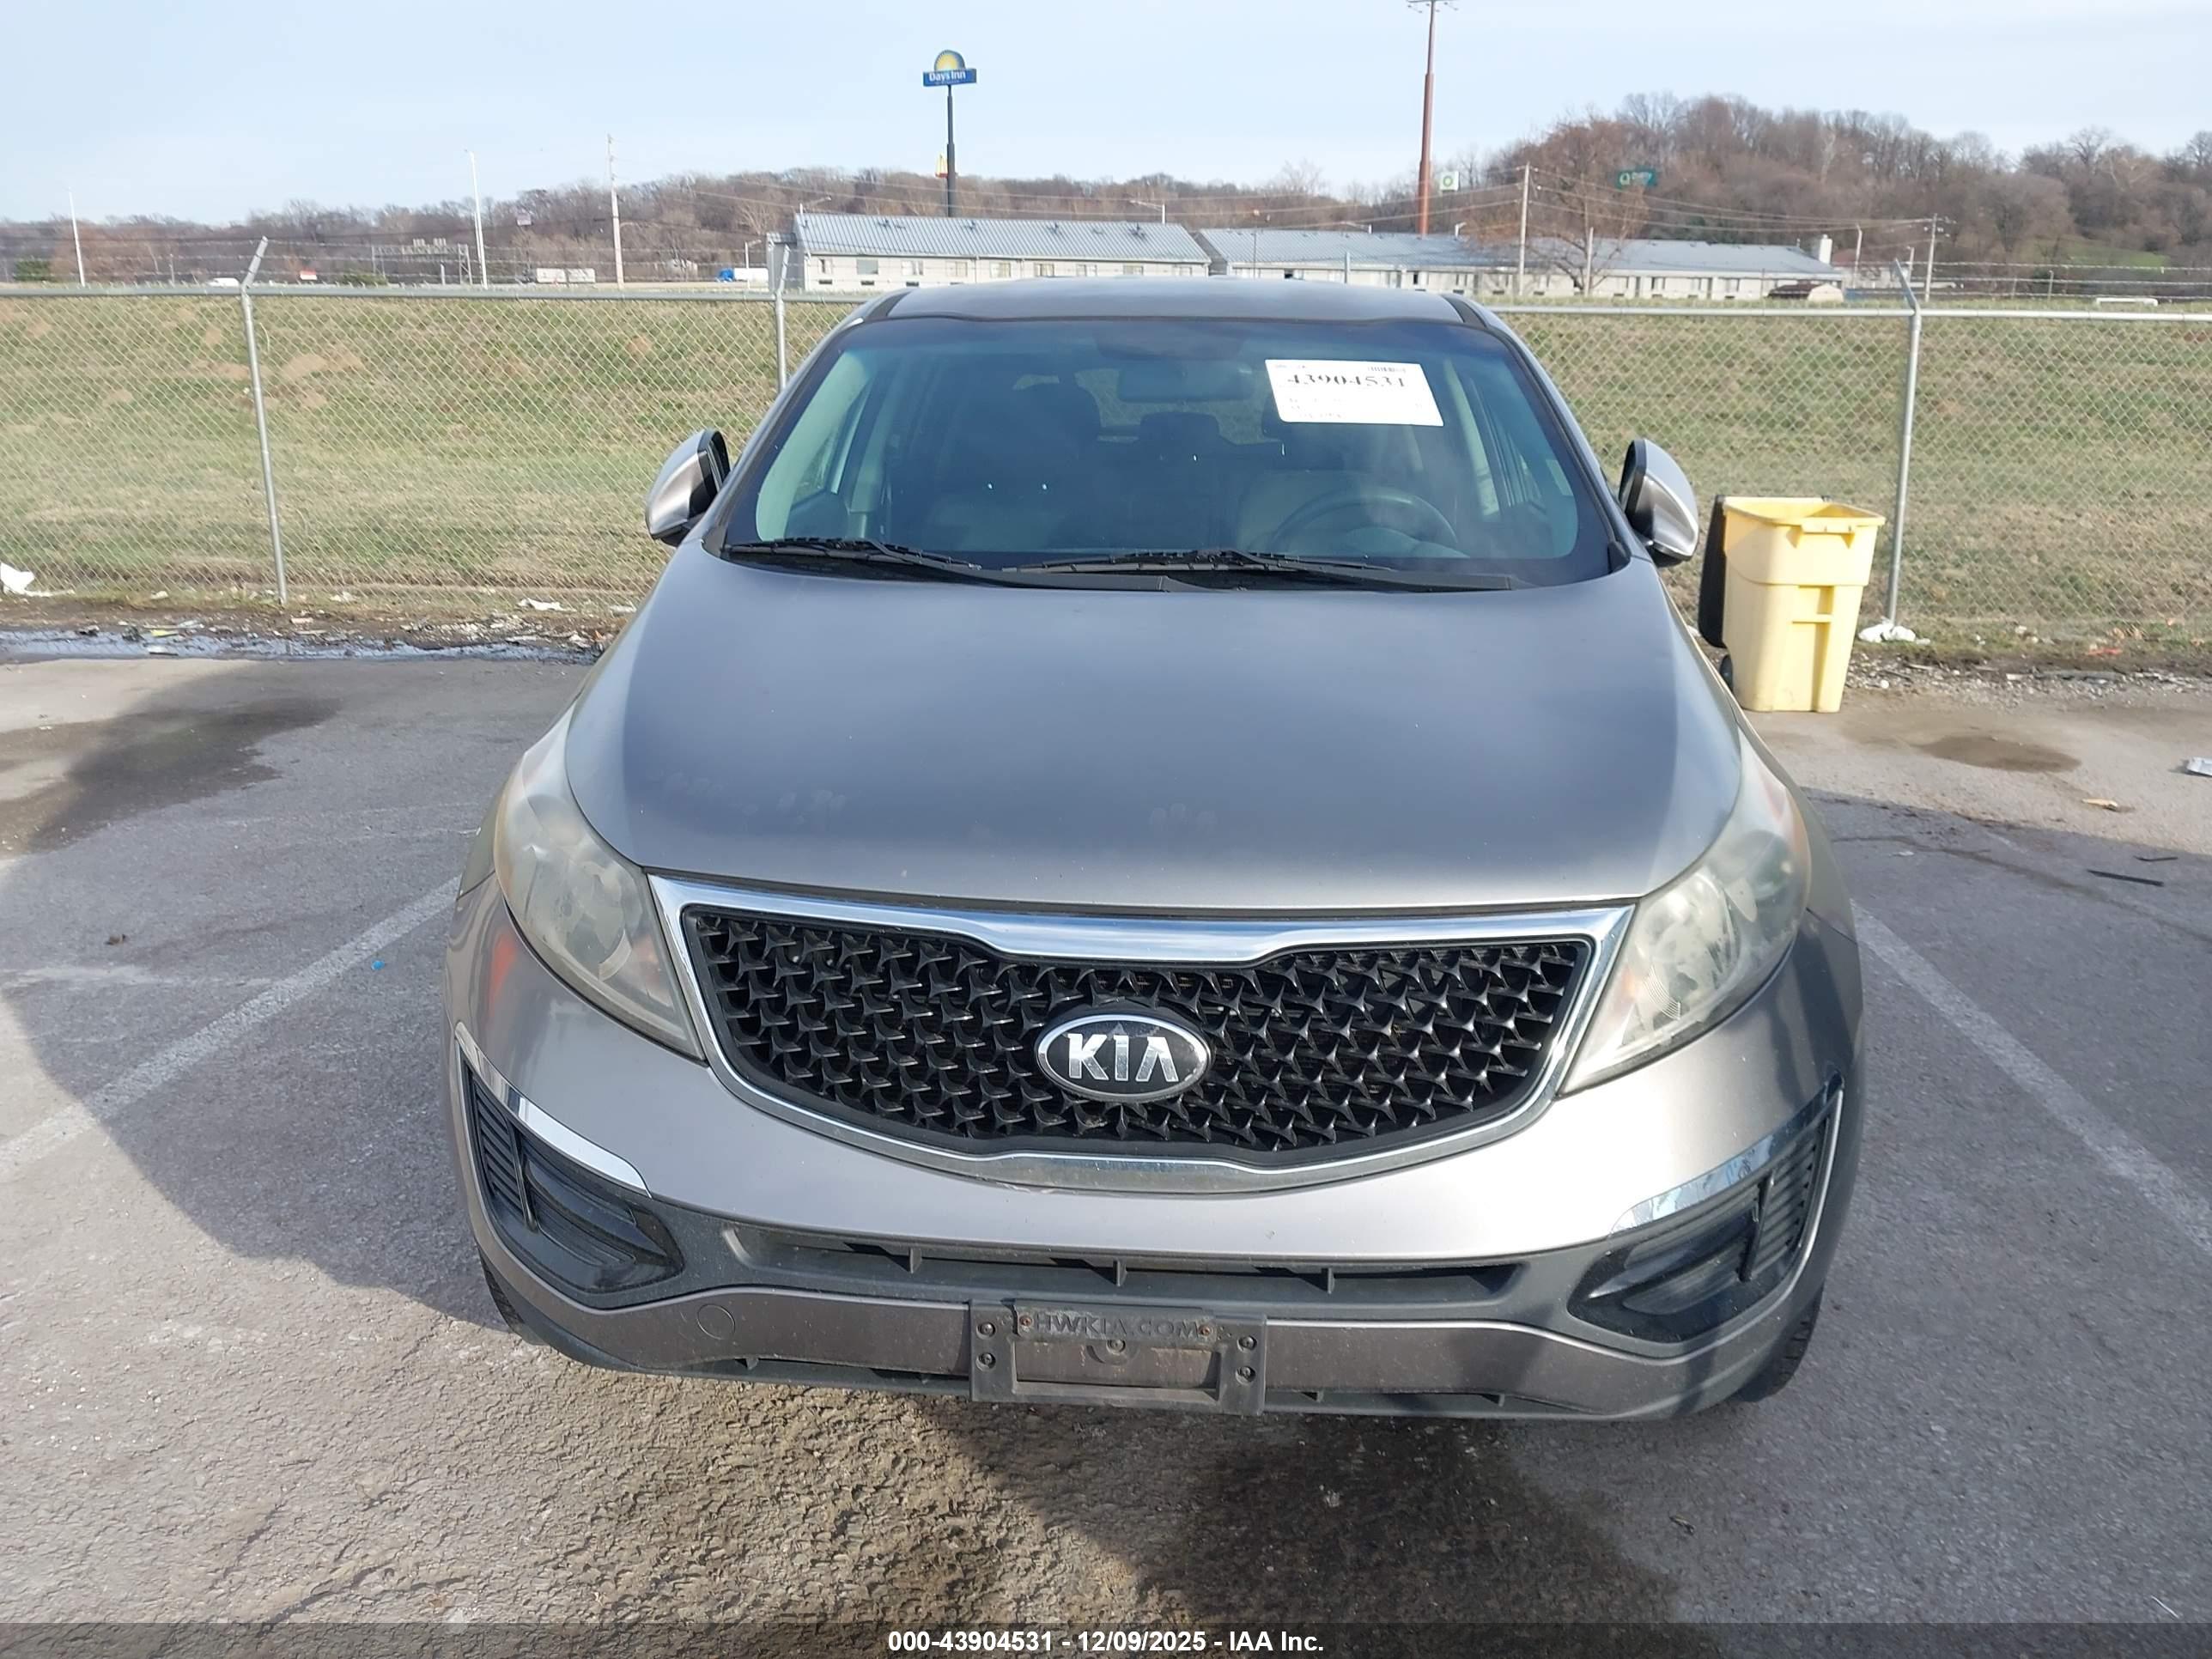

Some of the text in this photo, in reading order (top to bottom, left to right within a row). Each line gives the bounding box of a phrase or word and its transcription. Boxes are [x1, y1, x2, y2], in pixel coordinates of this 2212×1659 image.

[929, 70, 966, 82] Days Inn
[1287, 374, 1406, 387] 43904531
[1067, 1033, 1180, 1083] KIA
